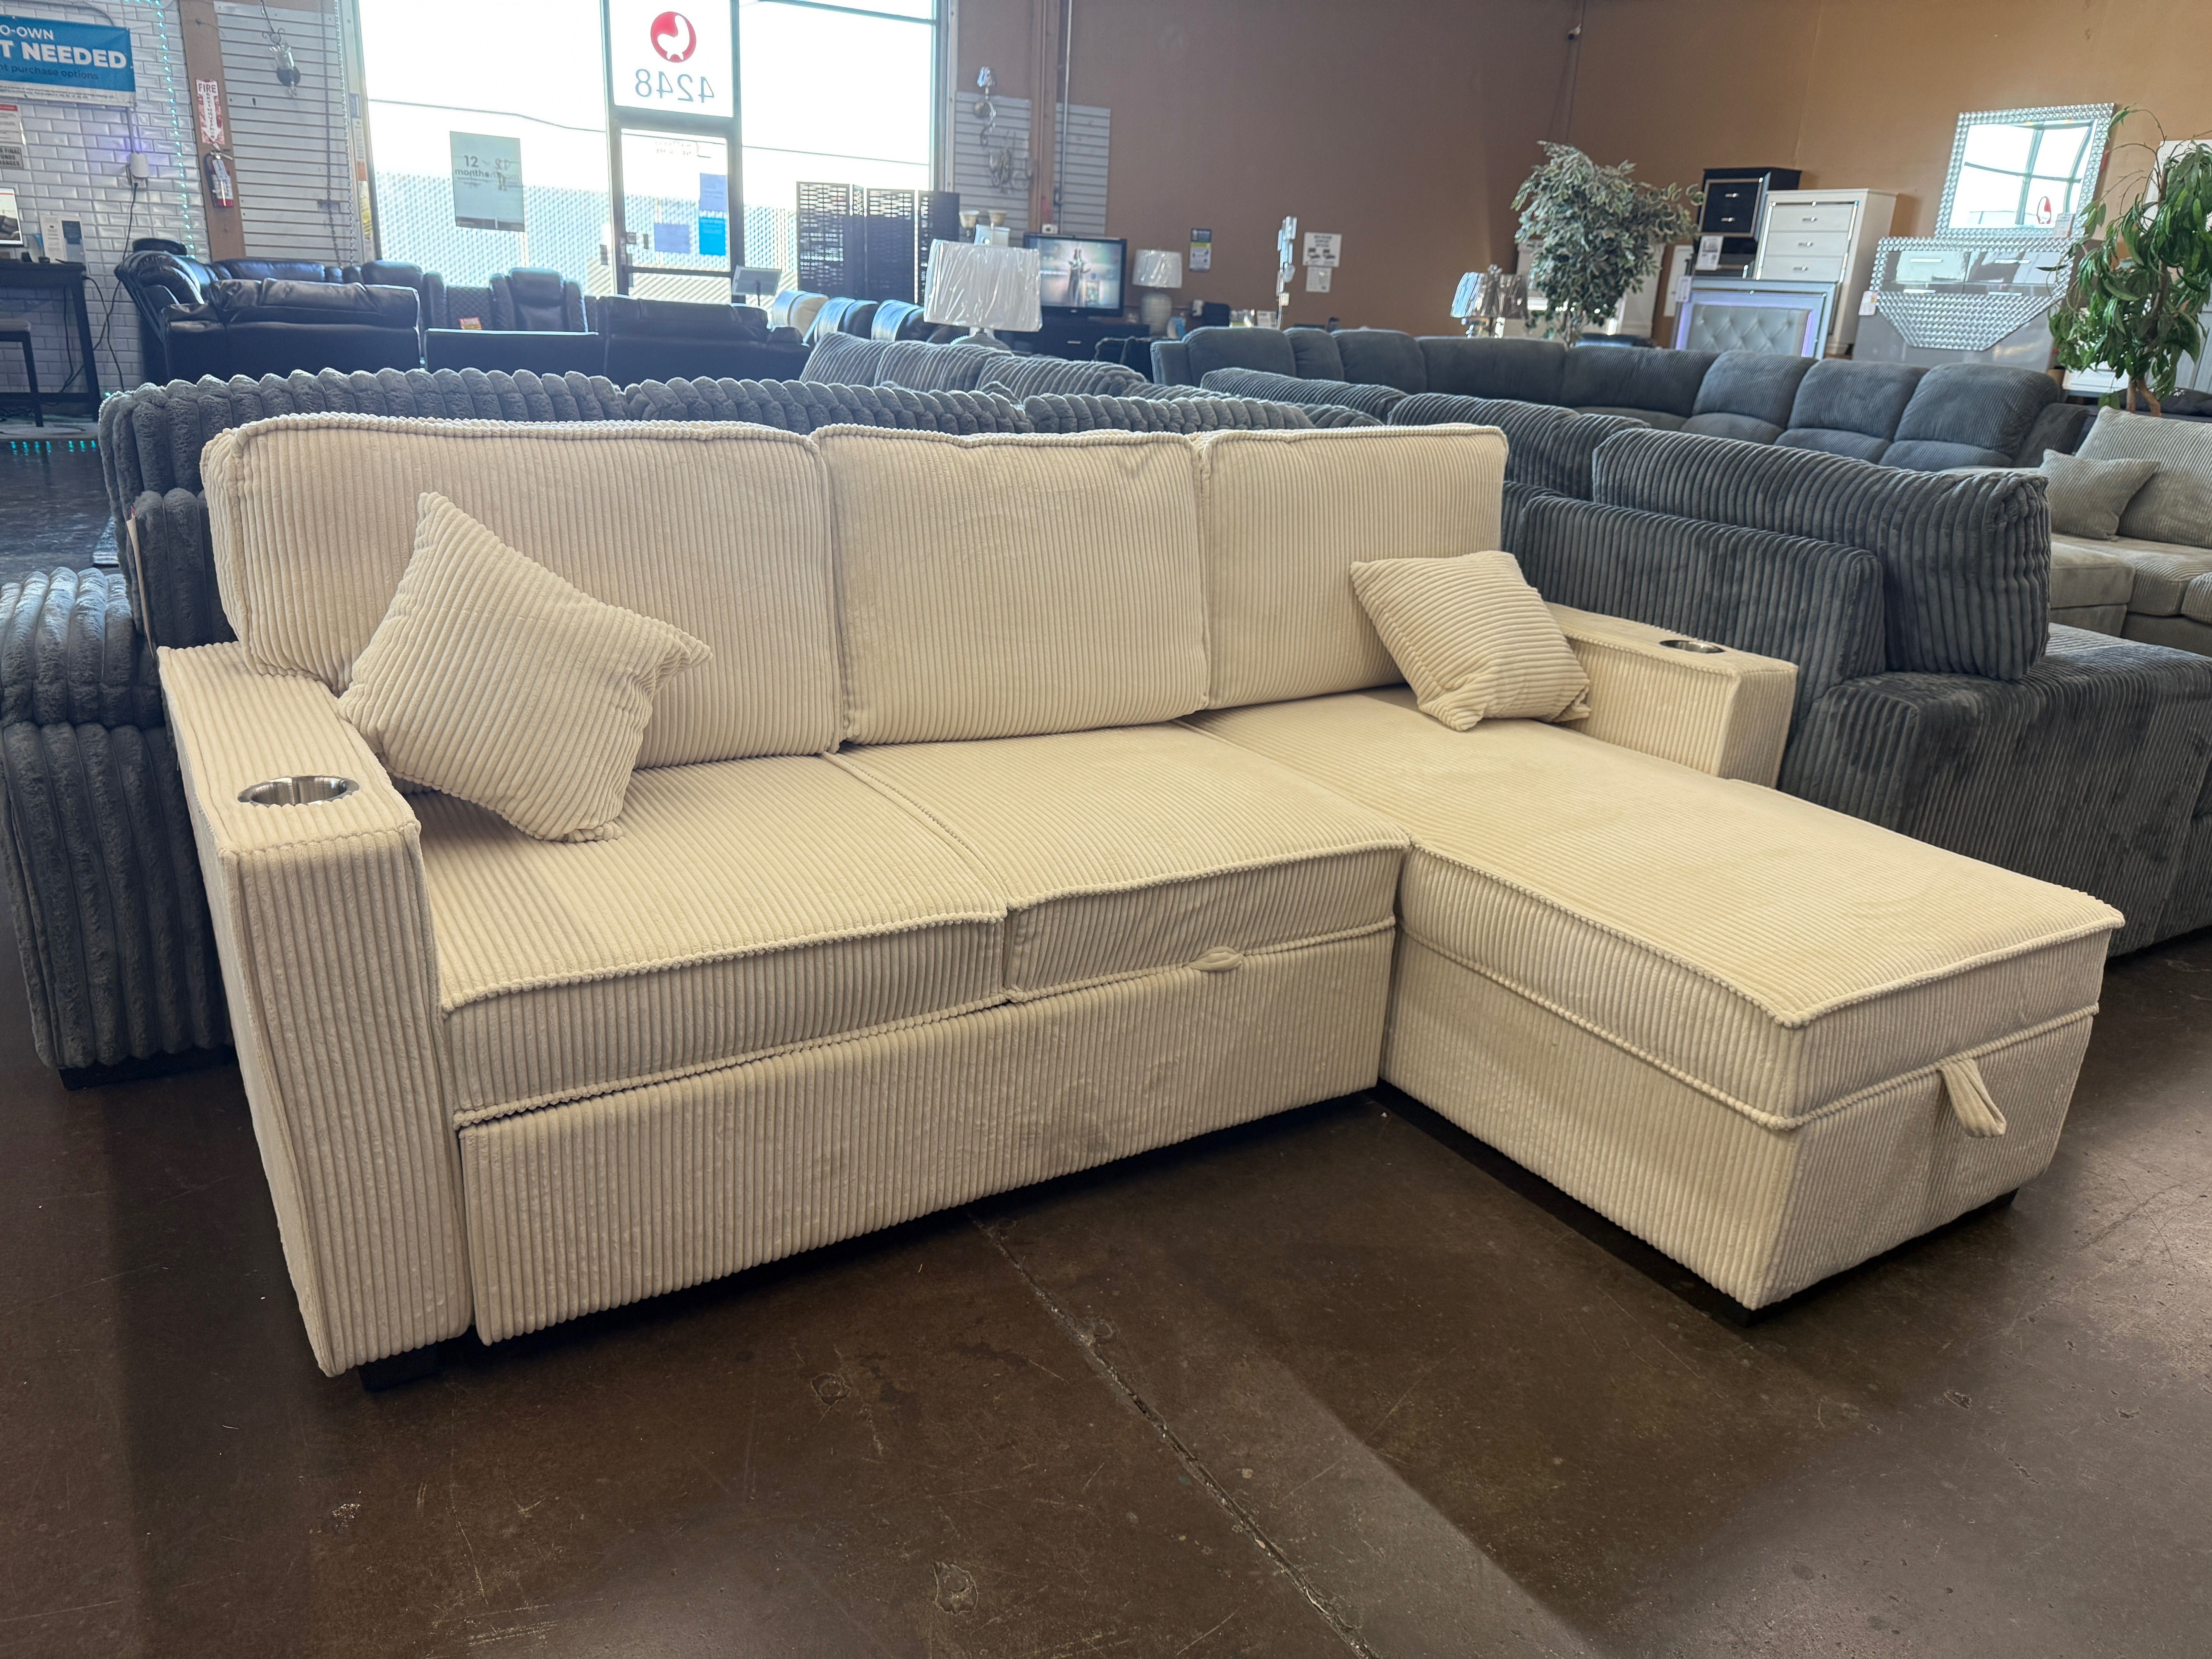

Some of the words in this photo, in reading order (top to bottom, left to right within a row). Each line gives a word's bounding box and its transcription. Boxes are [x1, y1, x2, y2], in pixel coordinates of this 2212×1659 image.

[21, 41, 127, 69] NEEDED
[11, 65, 58, 76] purchase
[61, 70, 99, 79] options
[198, 83, 216, 93] FIRE
[464, 155, 479, 167] 12
